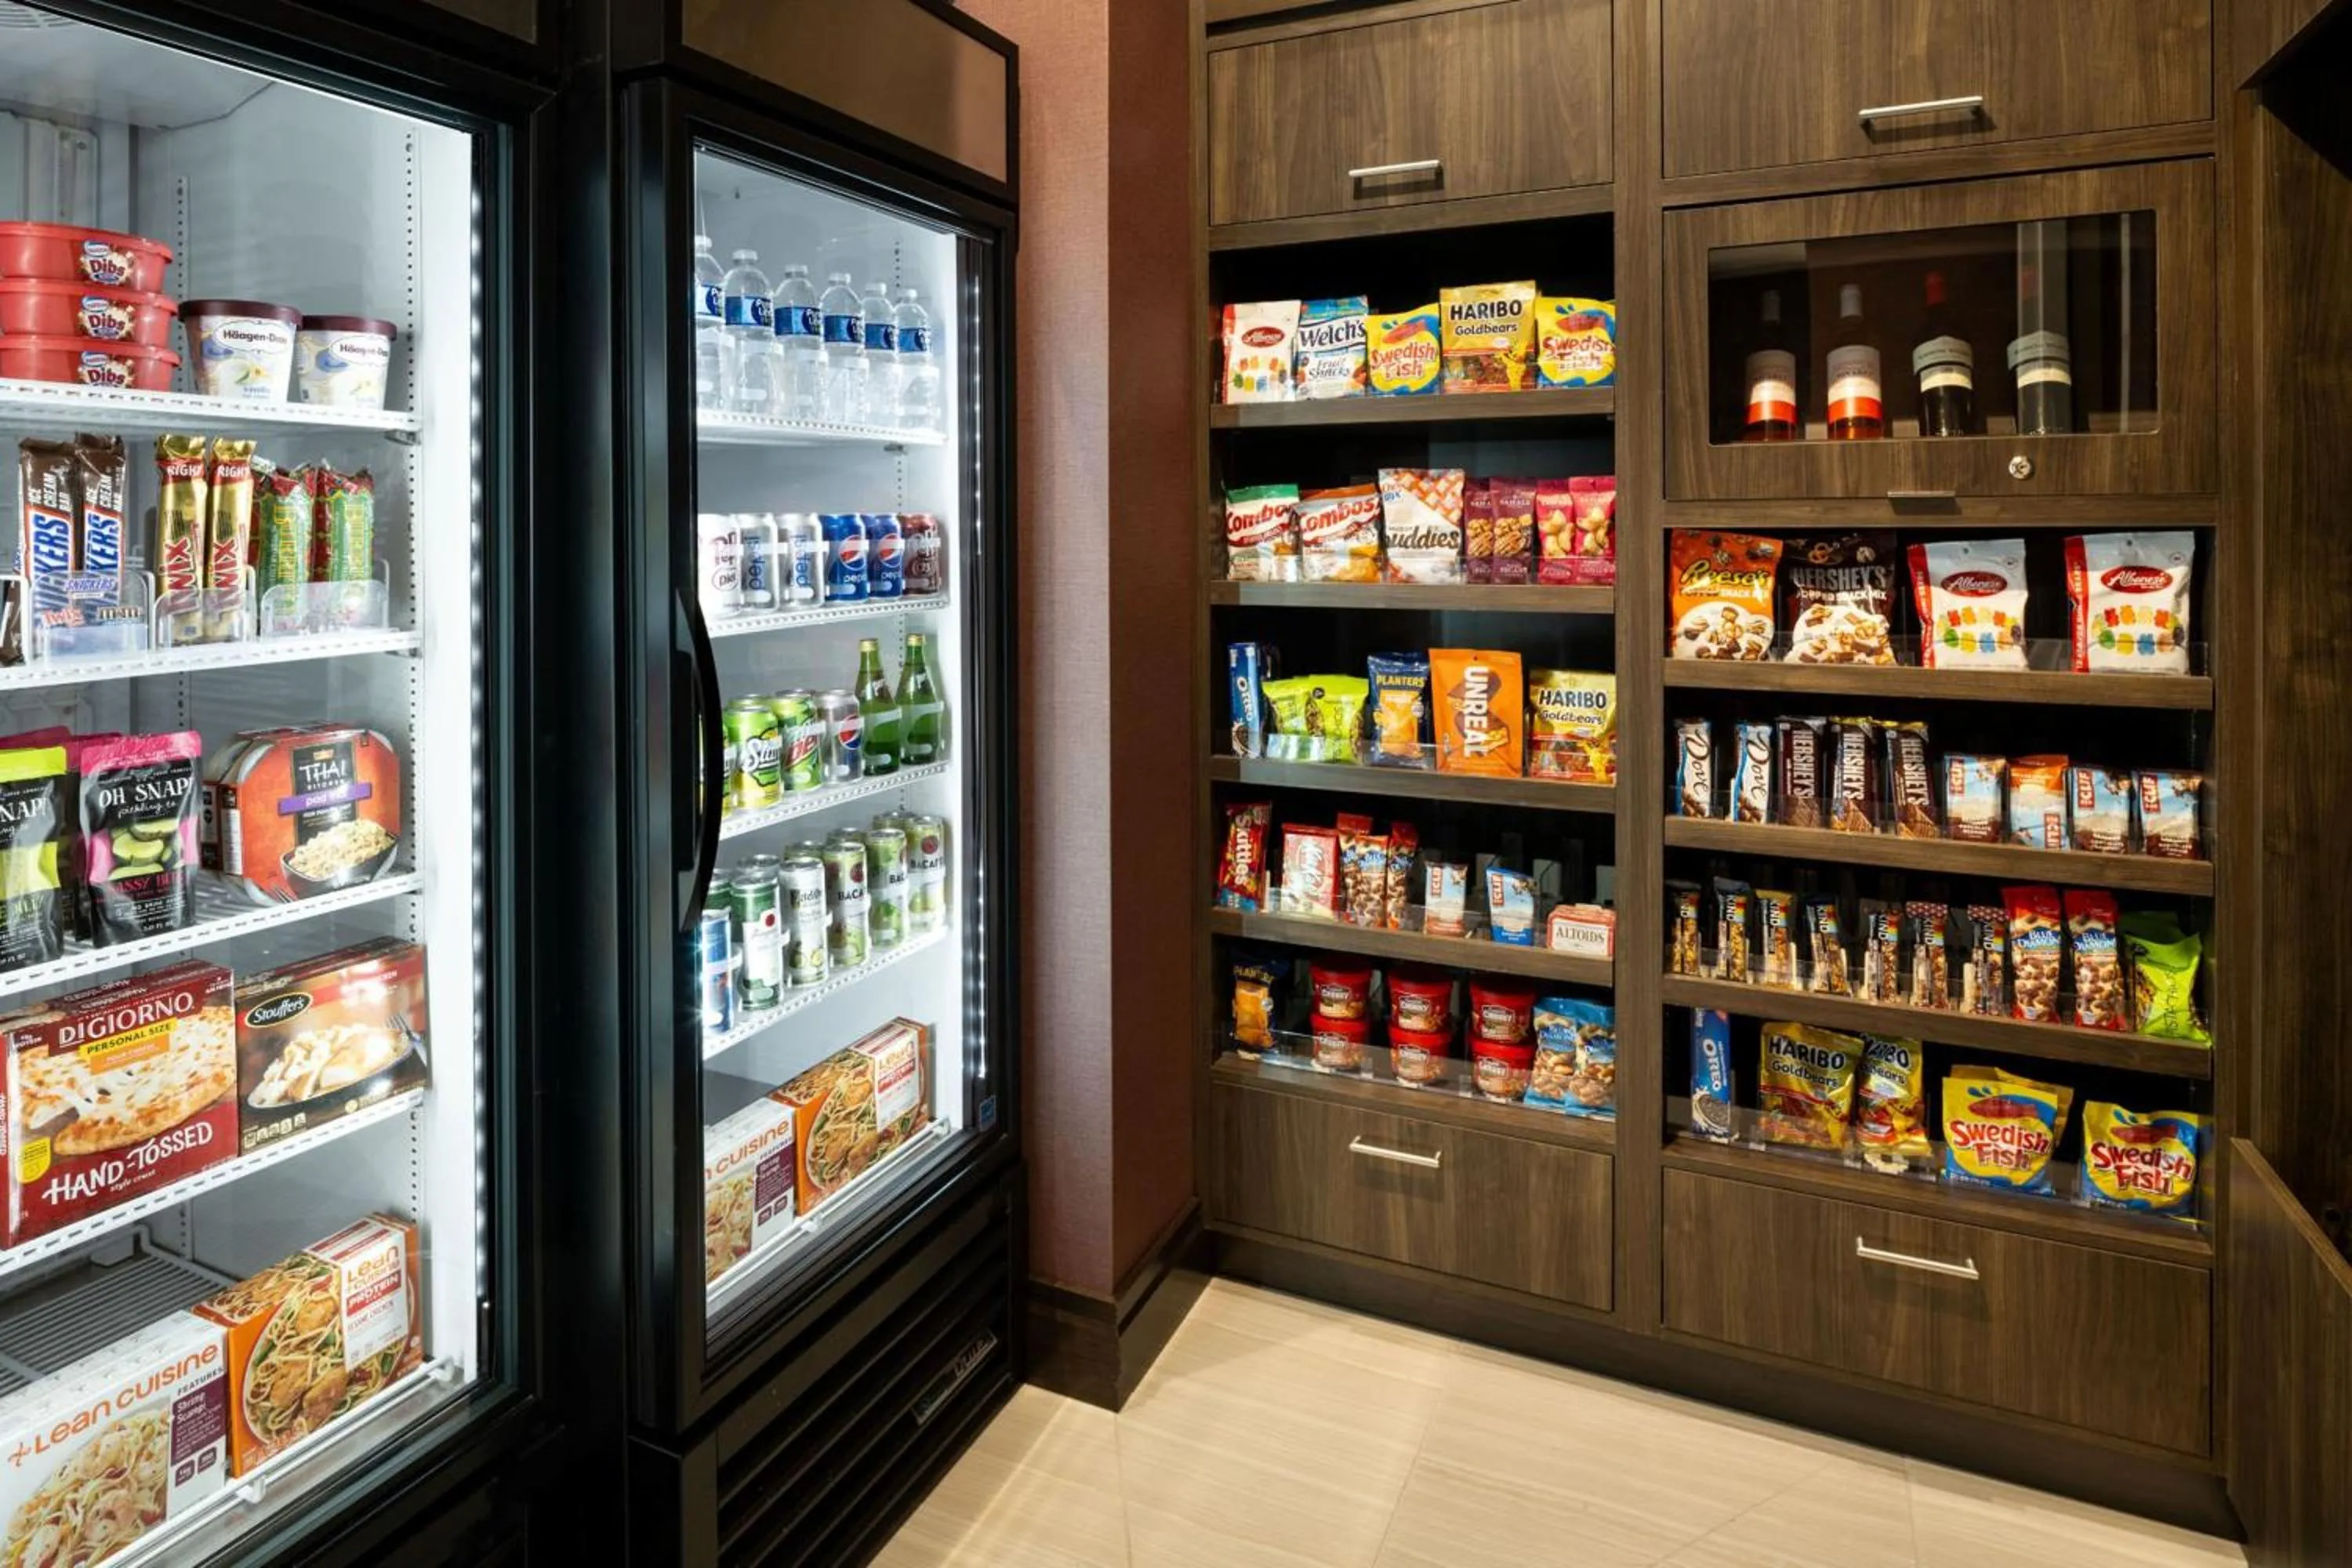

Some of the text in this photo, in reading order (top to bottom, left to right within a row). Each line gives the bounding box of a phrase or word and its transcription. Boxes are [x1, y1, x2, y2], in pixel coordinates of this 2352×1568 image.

[89, 258, 126, 276] Dibs
[88, 314, 125, 331] Dibs
[1450, 299, 1523, 321] HARIBO
[1300, 321, 1366, 349] Welch's
[1454, 322, 1518, 336] Goldbears
[1370, 341, 1436, 369] Swedish
[87, 367, 125, 384] Dibs
[1385, 361, 1423, 379] Fish
[216, 463, 250, 477] RIGHT
[1680, 558, 1769, 588] Reese's
[1791, 565, 1886, 591] HERSHEY'S
[2107, 570, 2167, 587] Albanese
[1376, 674, 1425, 688] PLANTERS
[1236, 676, 1253, 722] OREO
[1464, 665, 1489, 758] UNREAL
[1538, 689, 1607, 709] HARIBO
[1541, 709, 1605, 726] Goldbears
[299, 759, 347, 782] THAI
[1685, 728, 1711, 797] Dove
[1747, 730, 1771, 802] Dove
[1791, 729, 1816, 800] HERSHEY'S
[1842, 731, 1866, 801] HERSHEY'S
[1899, 737, 1930, 807] HERSHEY'S
[99, 789, 126, 808] OH
[838, 888, 864, 902] BACA
[1555, 925, 1605, 943] ALTOIDS
[252, 996, 305, 1024] Stouffer's
[87, 1023, 172, 1054] PERSONAL SIZE
[1768, 1035, 1846, 1070] HARIBO
[1702, 1038, 1721, 1092] OREO
[1771, 1060, 1839, 1089] Goldbears
[716, 1120, 789, 1174] cuisine
[1949, 1119, 2051, 1156] Swedish
[42, 1121, 213, 1205] HAND-TOSSED
[1973, 1142, 2033, 1171] Fish
[2090, 1141, 2194, 1181] Swedish
[2115, 1163, 2173, 1195] Fish
[177, 1366, 226, 1396] FEATURES
[34, 1400, 111, 1454] Lean
[116, 1341, 220, 1408] cuisine
